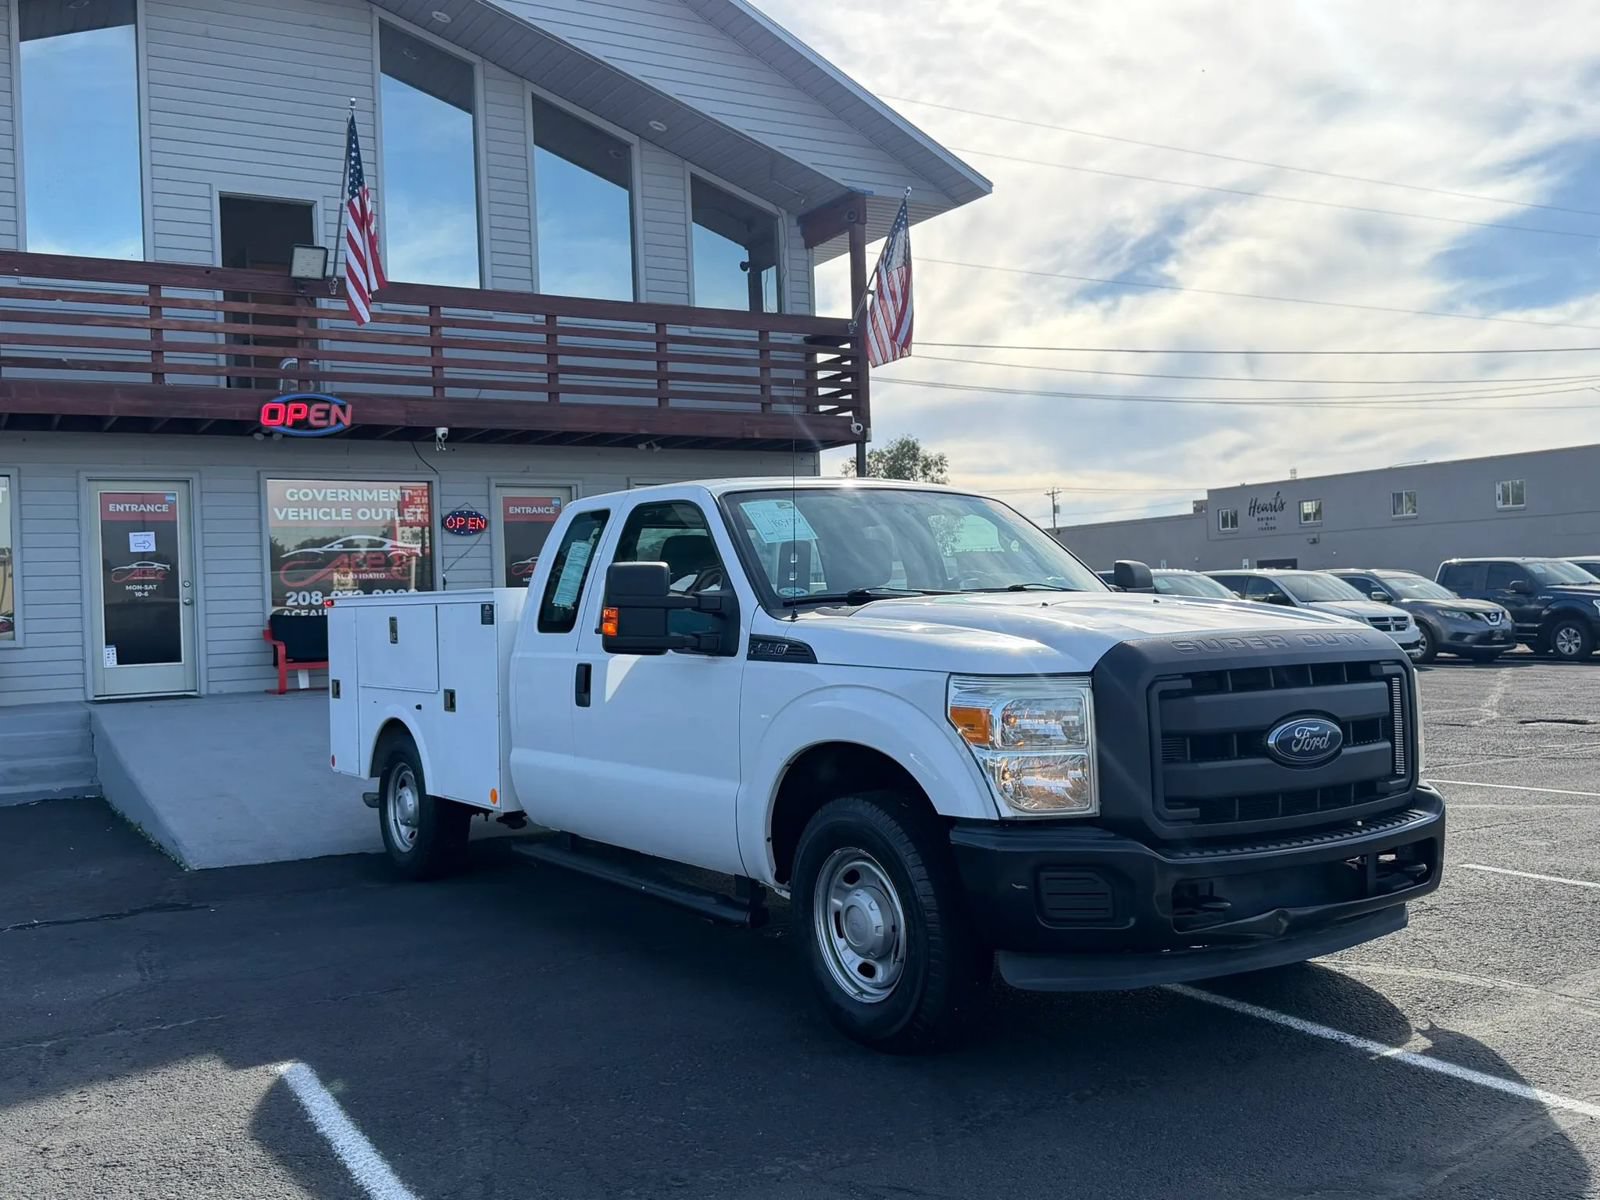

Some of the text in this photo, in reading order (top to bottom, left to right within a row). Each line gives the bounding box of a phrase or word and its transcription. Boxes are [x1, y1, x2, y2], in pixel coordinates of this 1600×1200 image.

[261, 403, 352, 427] OPEN
[286, 488, 413, 502] GOVERNMENT
[108, 503, 169, 513] ENTRANCE
[509, 506, 556, 515] ENTRANCE
[1248, 491, 1286, 517] Hearts
[274, 507, 424, 521] VEHICLE OUTLET
[446, 517, 486, 530] OPEN
[1171, 631, 1371, 655] SUPER DUTY
[1291, 726, 1332, 753] Ford
